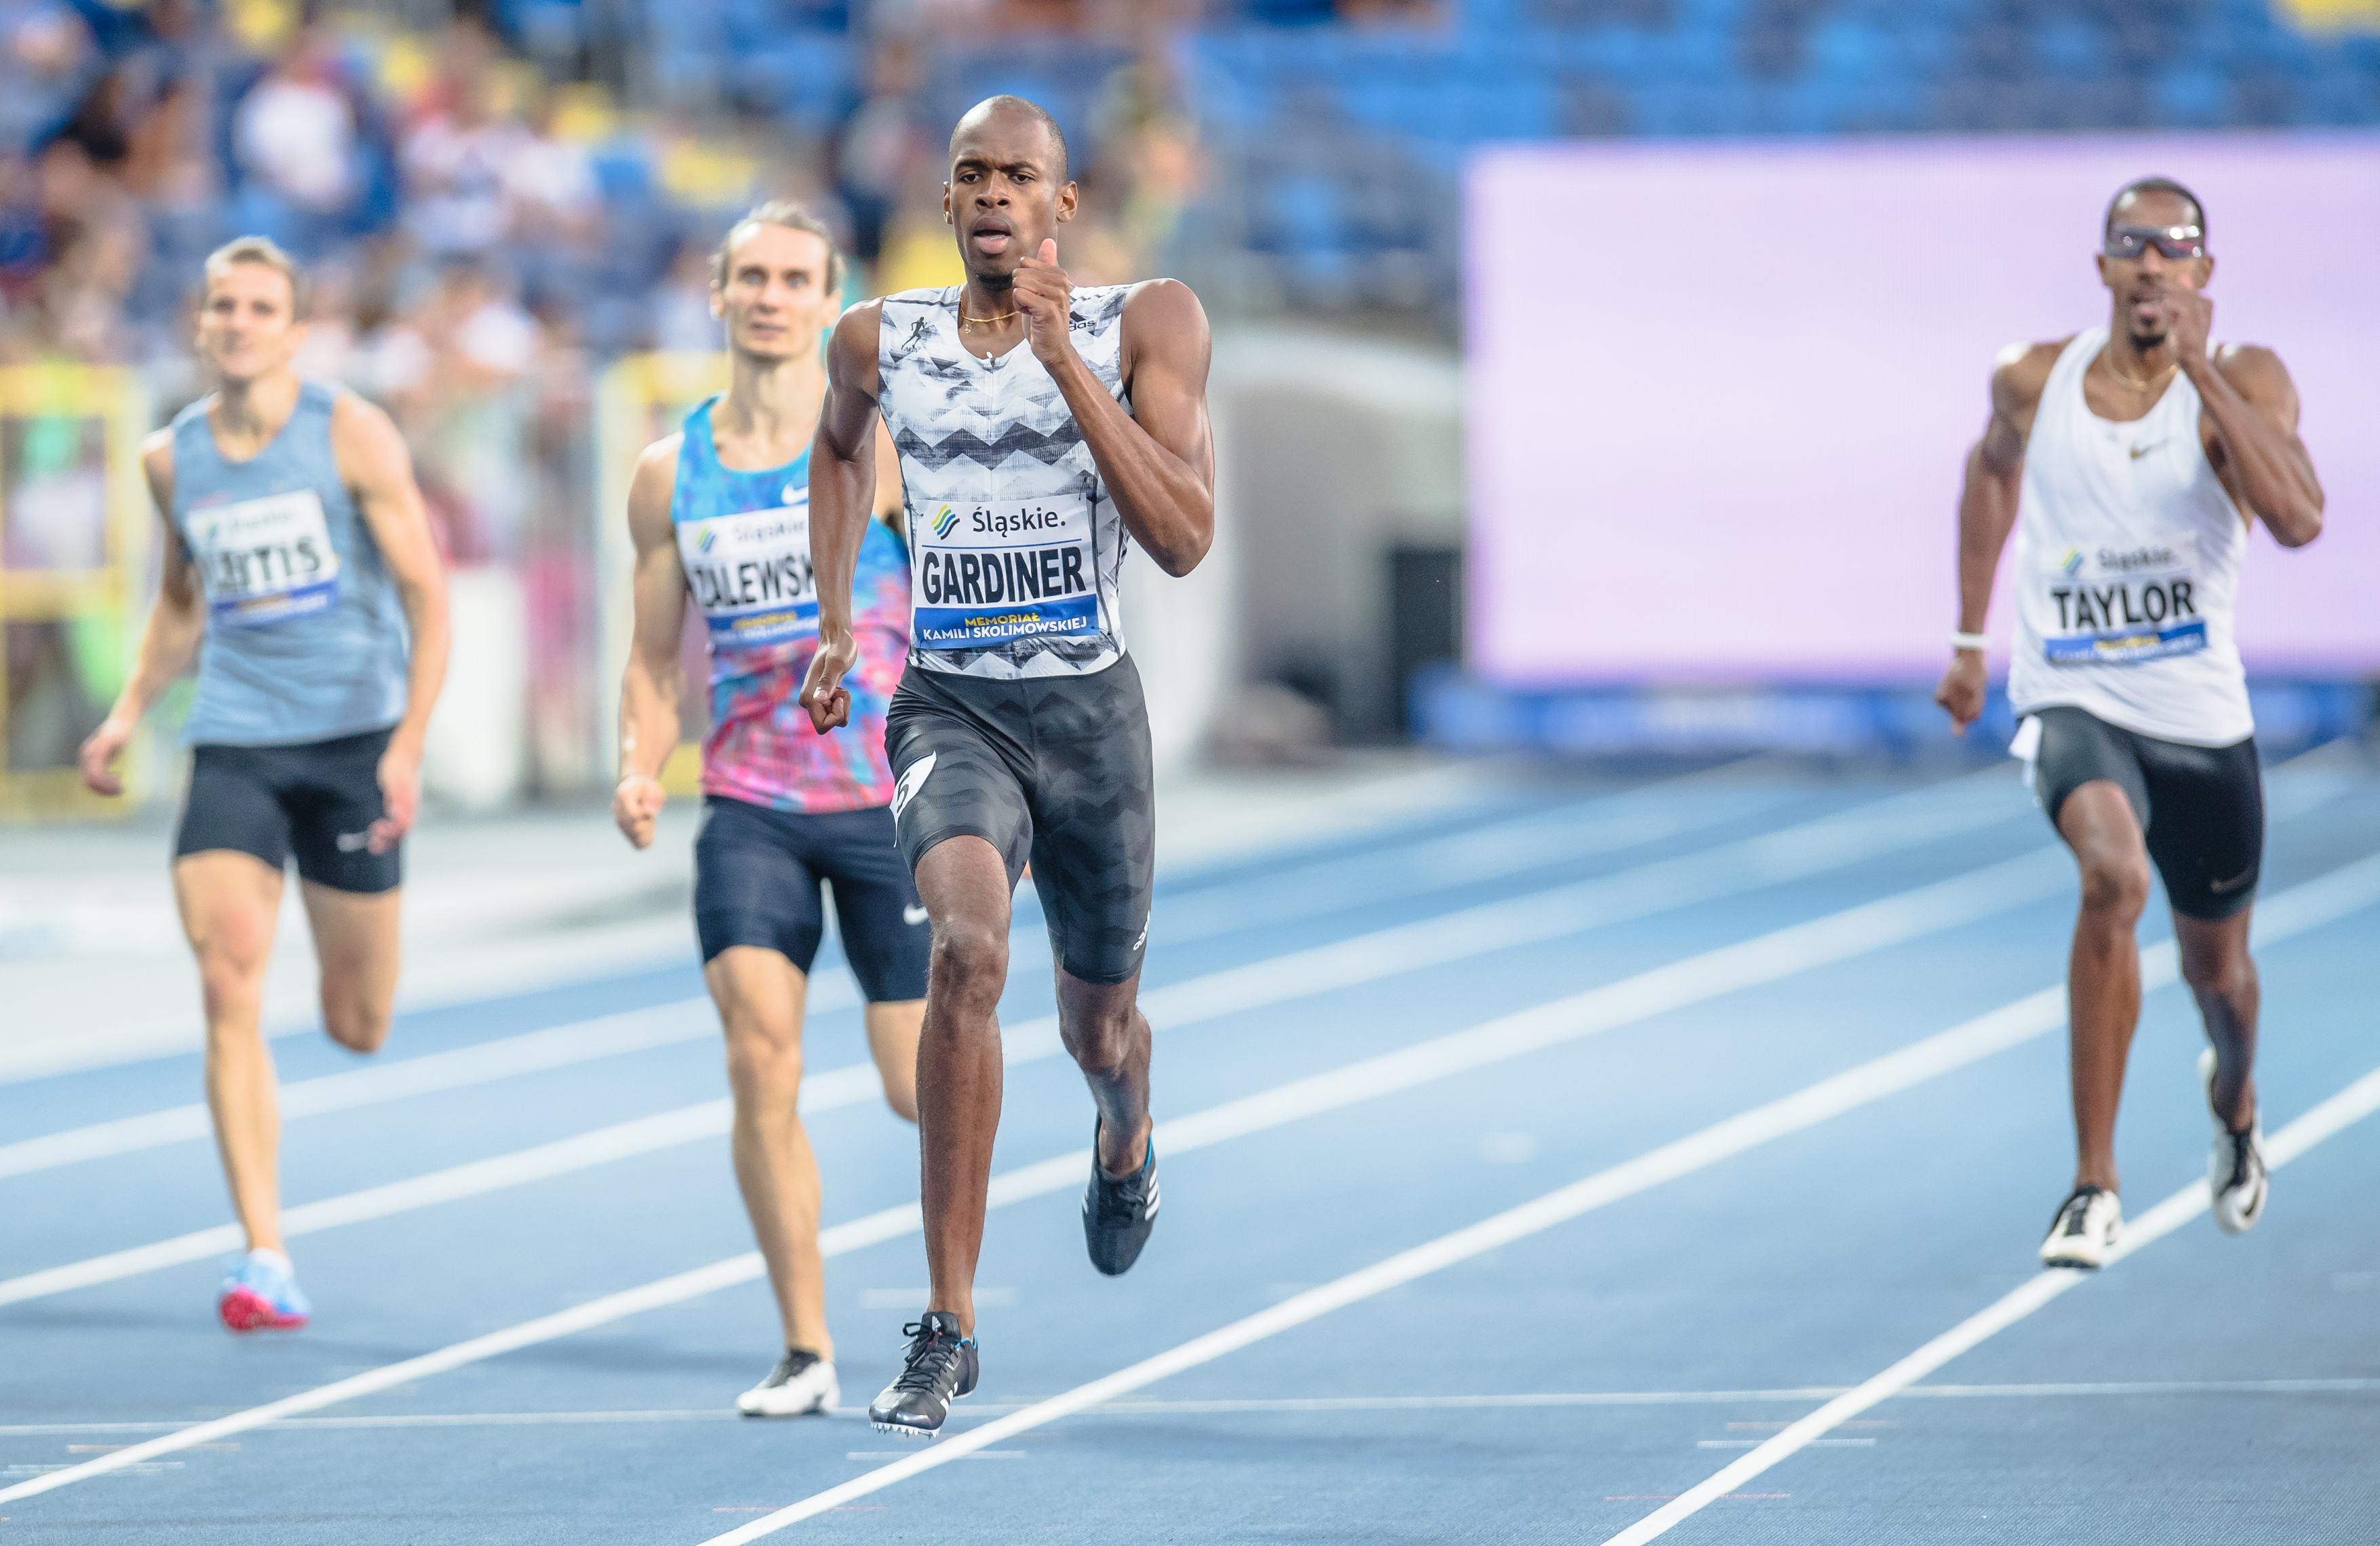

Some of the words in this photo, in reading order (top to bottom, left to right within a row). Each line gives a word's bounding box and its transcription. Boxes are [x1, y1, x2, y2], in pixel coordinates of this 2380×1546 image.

[1069, 320, 1096, 332] das
[972, 506, 1066, 538] Śląskie.
[693, 553, 817, 608] ZALEWSK
[922, 546, 1087, 604] GARDINER
[964, 612, 1040, 627] MEMORIAŁ
[2050, 579, 2196, 630] TAYLOR
[922, 627, 970, 641] KAMILI
[973, 616, 1087, 639] SKOLIMOWSKIEJ
[897, 770, 910, 814] 5
